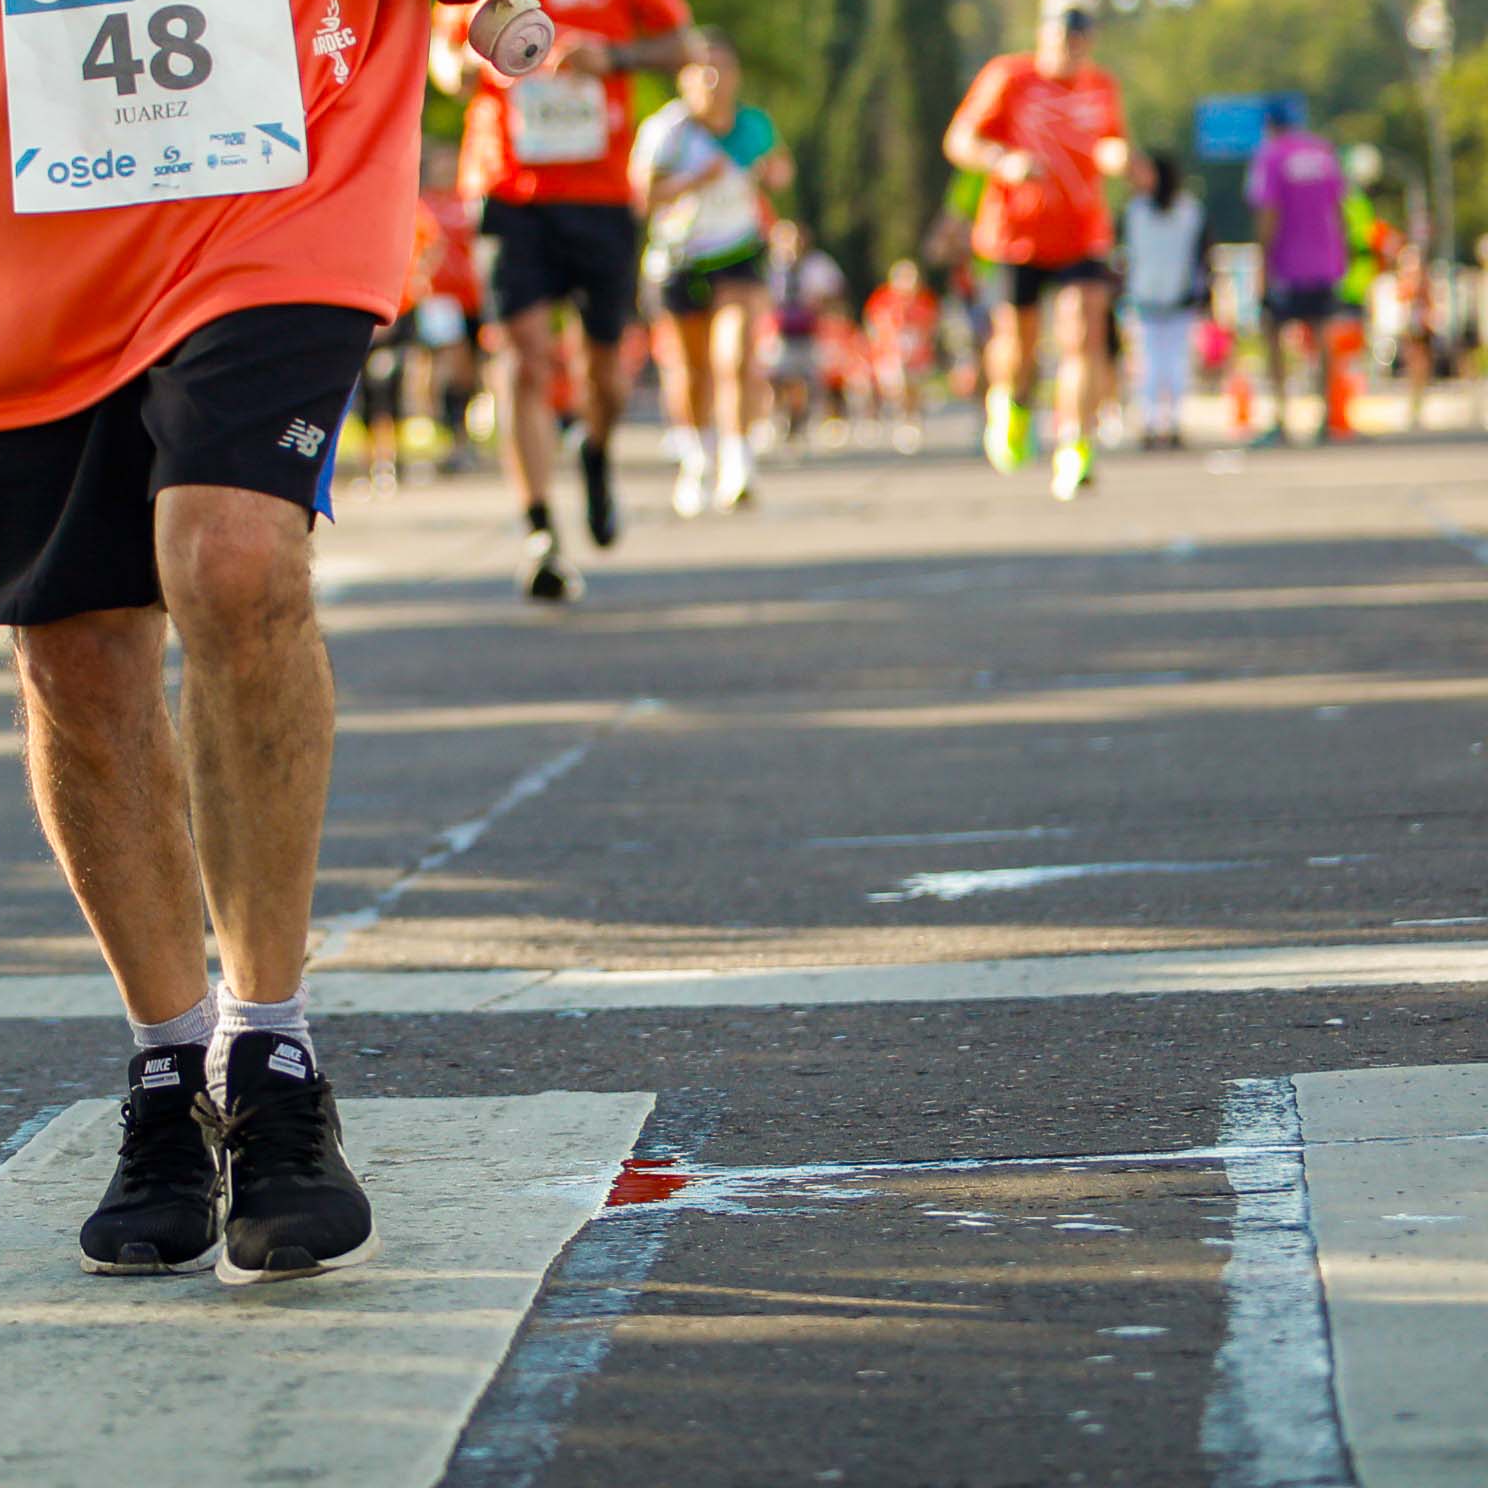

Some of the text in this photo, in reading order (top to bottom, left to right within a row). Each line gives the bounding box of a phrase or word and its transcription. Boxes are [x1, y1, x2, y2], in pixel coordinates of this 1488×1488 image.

[82, 4, 213, 96] 48
[114, 100, 190, 125] JUAREZ
[47, 148, 137, 188] osde
[274, 1042, 303, 1062] NIKE
[144, 1057, 173, 1074] NIKE
